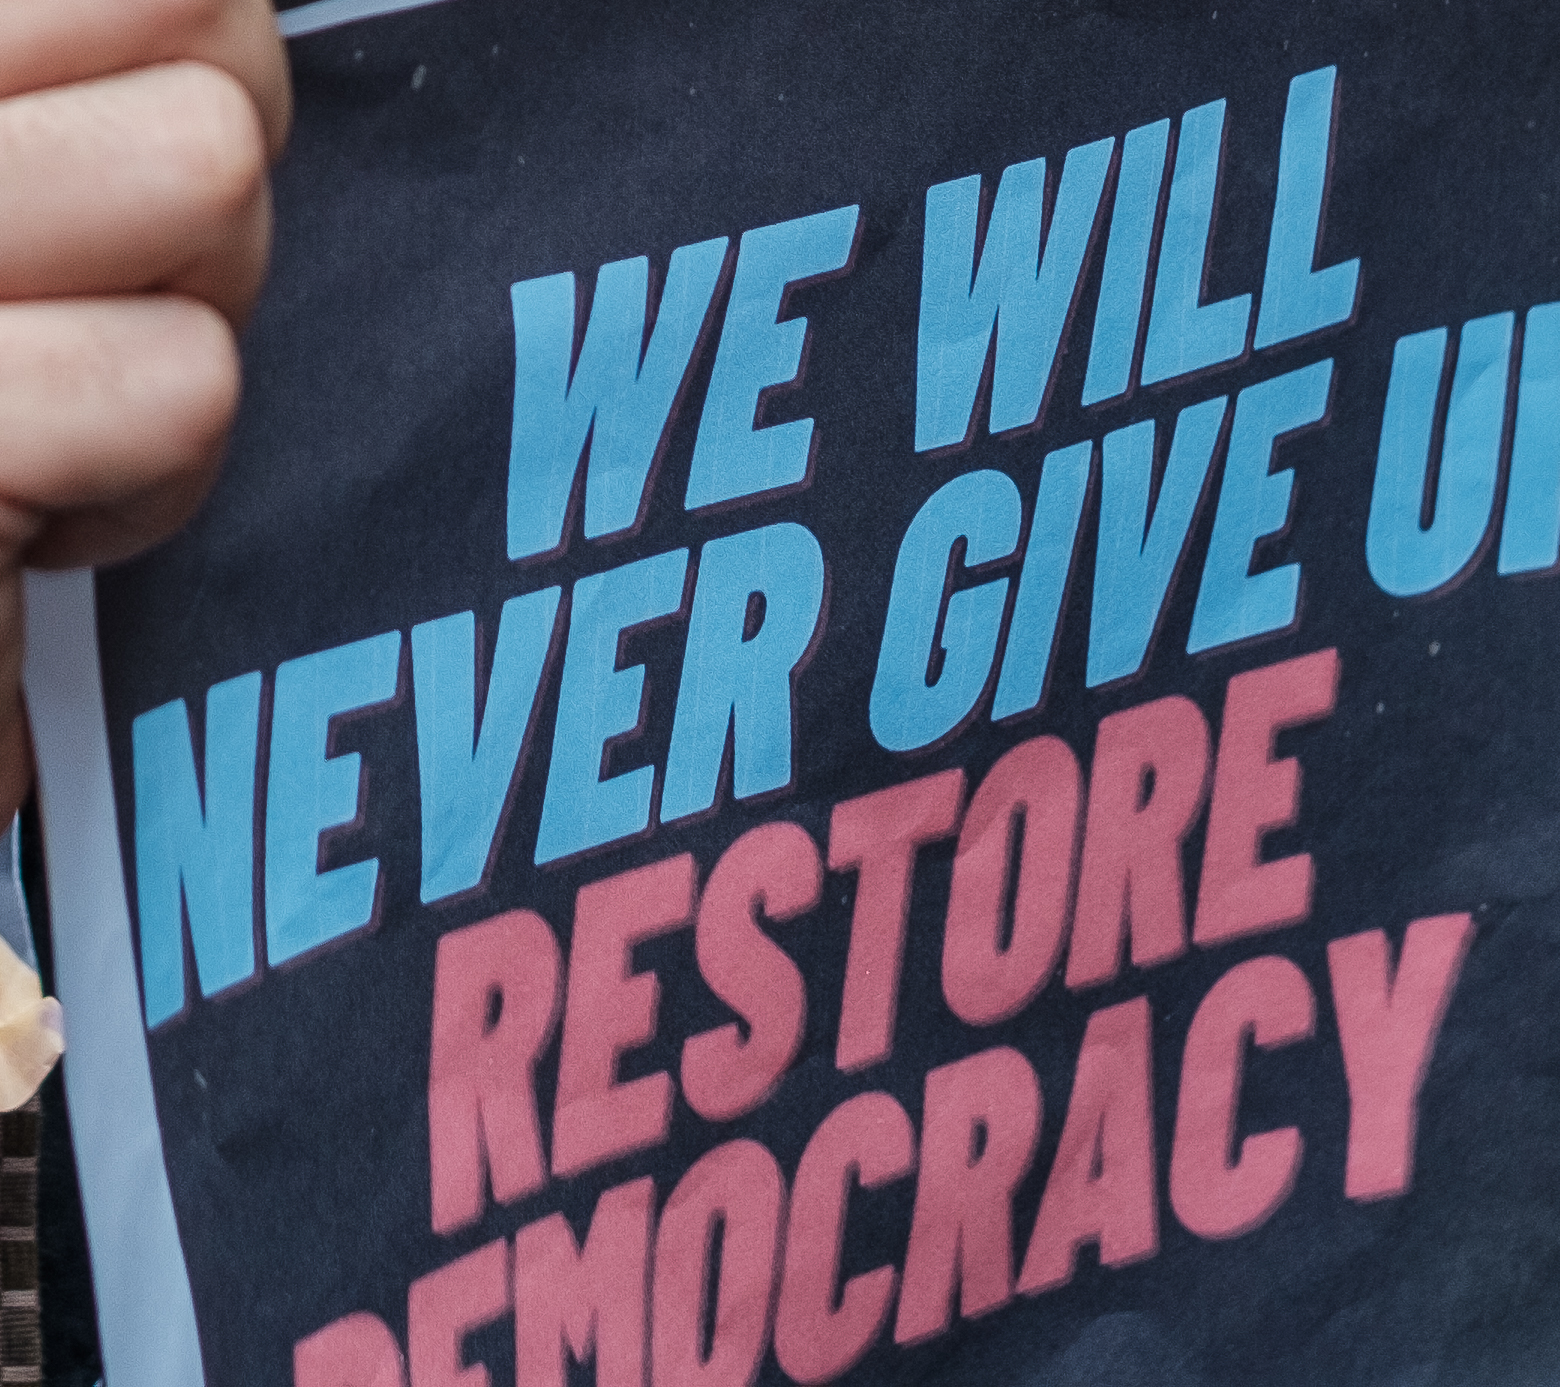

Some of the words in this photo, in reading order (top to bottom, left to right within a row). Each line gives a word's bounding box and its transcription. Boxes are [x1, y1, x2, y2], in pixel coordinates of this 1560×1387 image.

[505, 202, 861, 563] WE
[913, 63, 1362, 454] WILL
[131, 521, 827, 1032] NEVER
[867, 356, 1335, 753] GIVE
[427, 648, 1340, 1235] RESTORE
[292, 913, 1473, 1387] EMOCRACY
